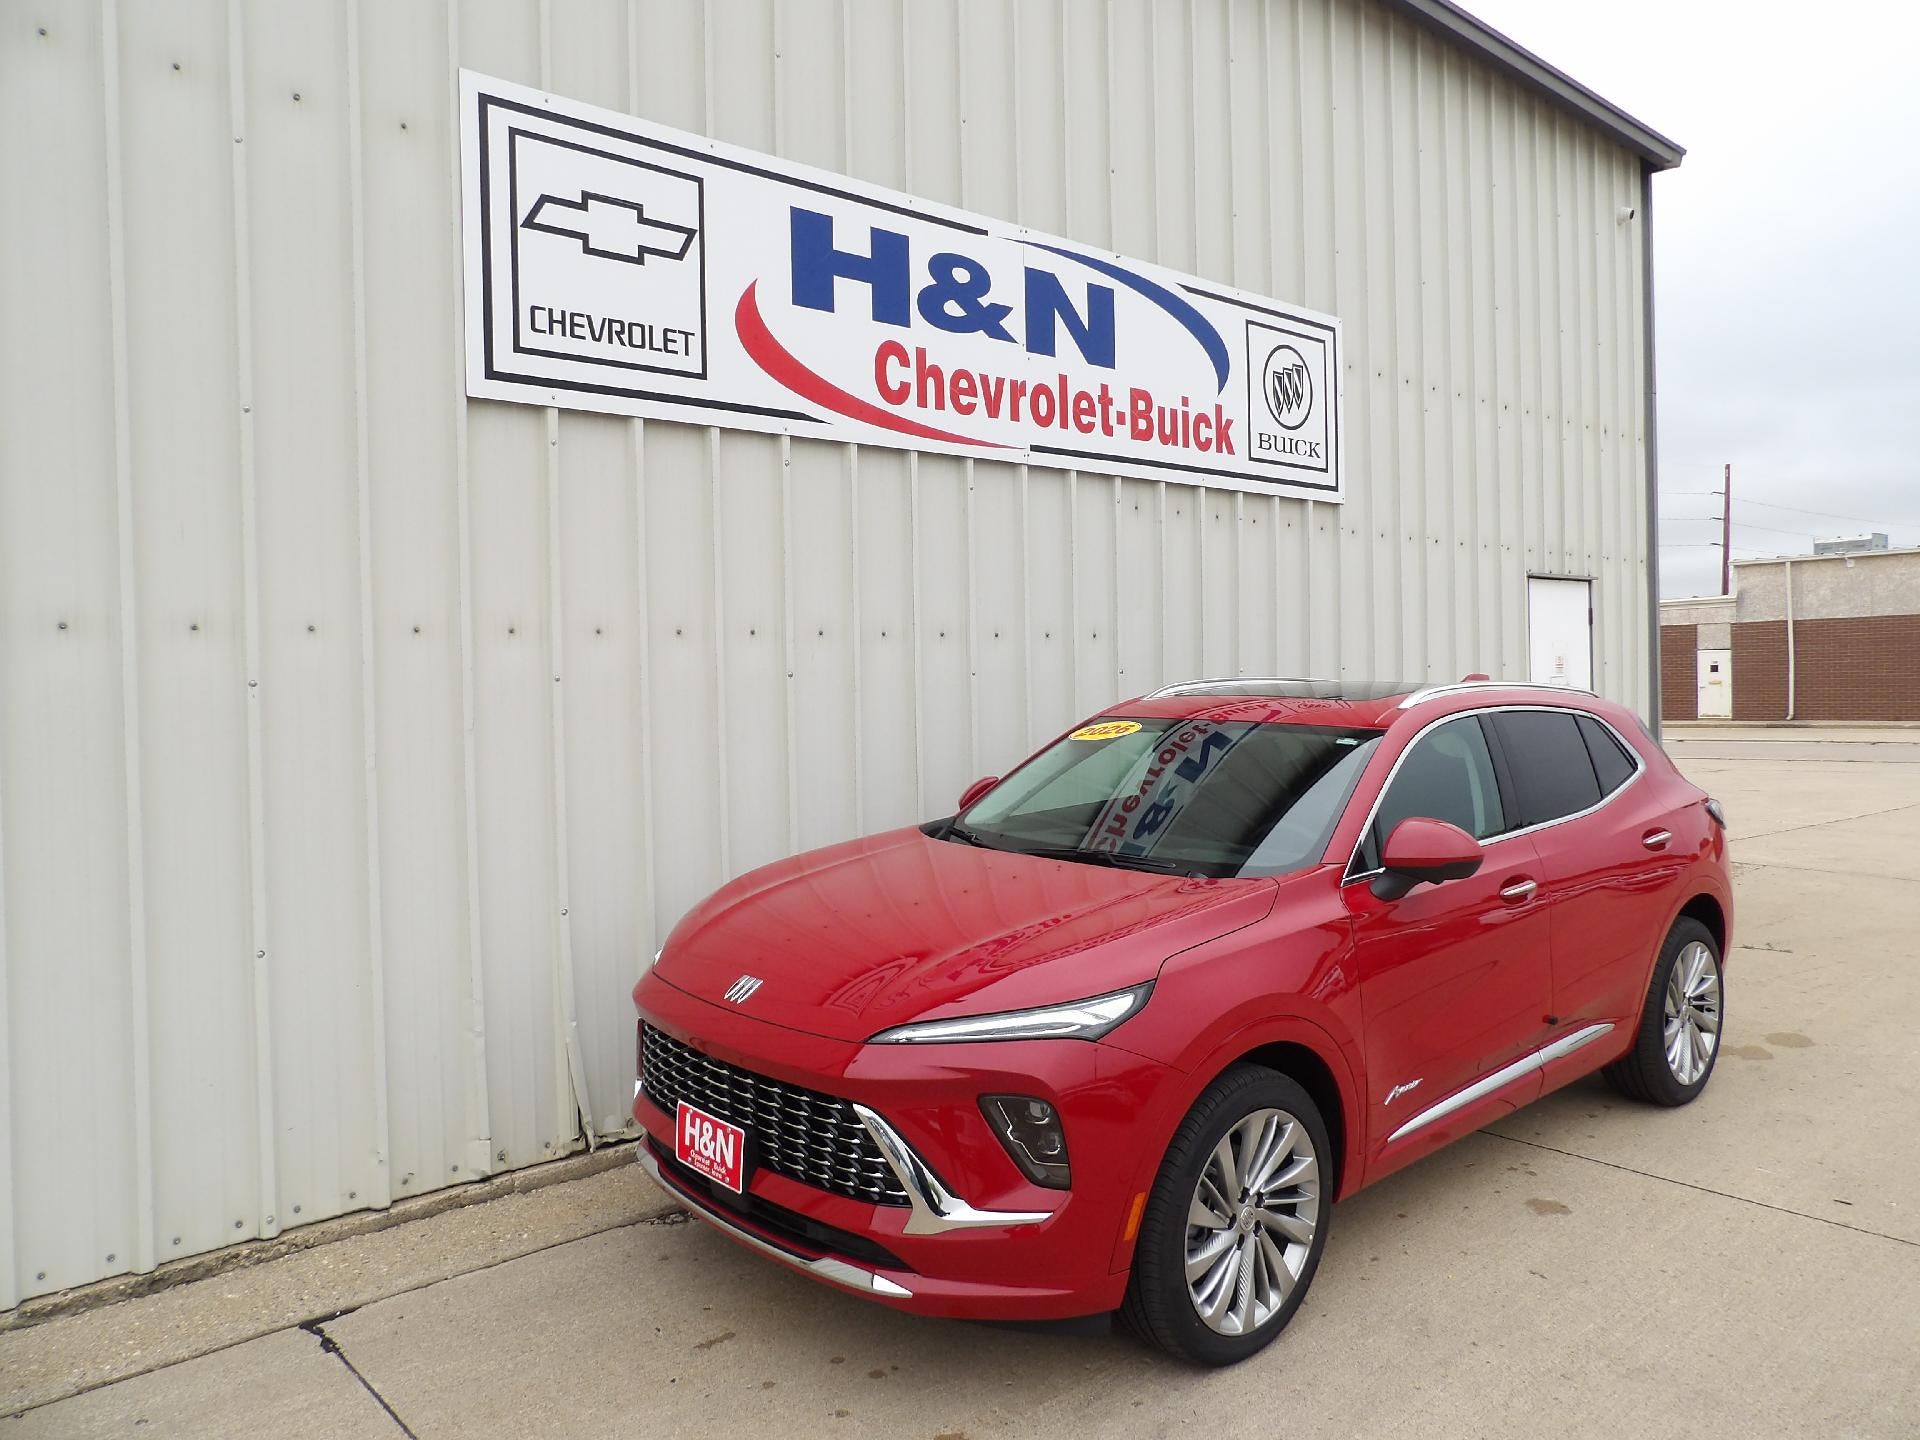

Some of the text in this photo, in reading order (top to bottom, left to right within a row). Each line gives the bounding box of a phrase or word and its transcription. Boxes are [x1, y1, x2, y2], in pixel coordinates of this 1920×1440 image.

[790, 205, 1116, 370] H&N
[529, 304, 696, 357] CHEVROLET
[874, 339, 1236, 456] Chevrolet-Buick
[1257, 432, 1321, 459] BUICK
[684, 1112, 735, 1169] H&N
